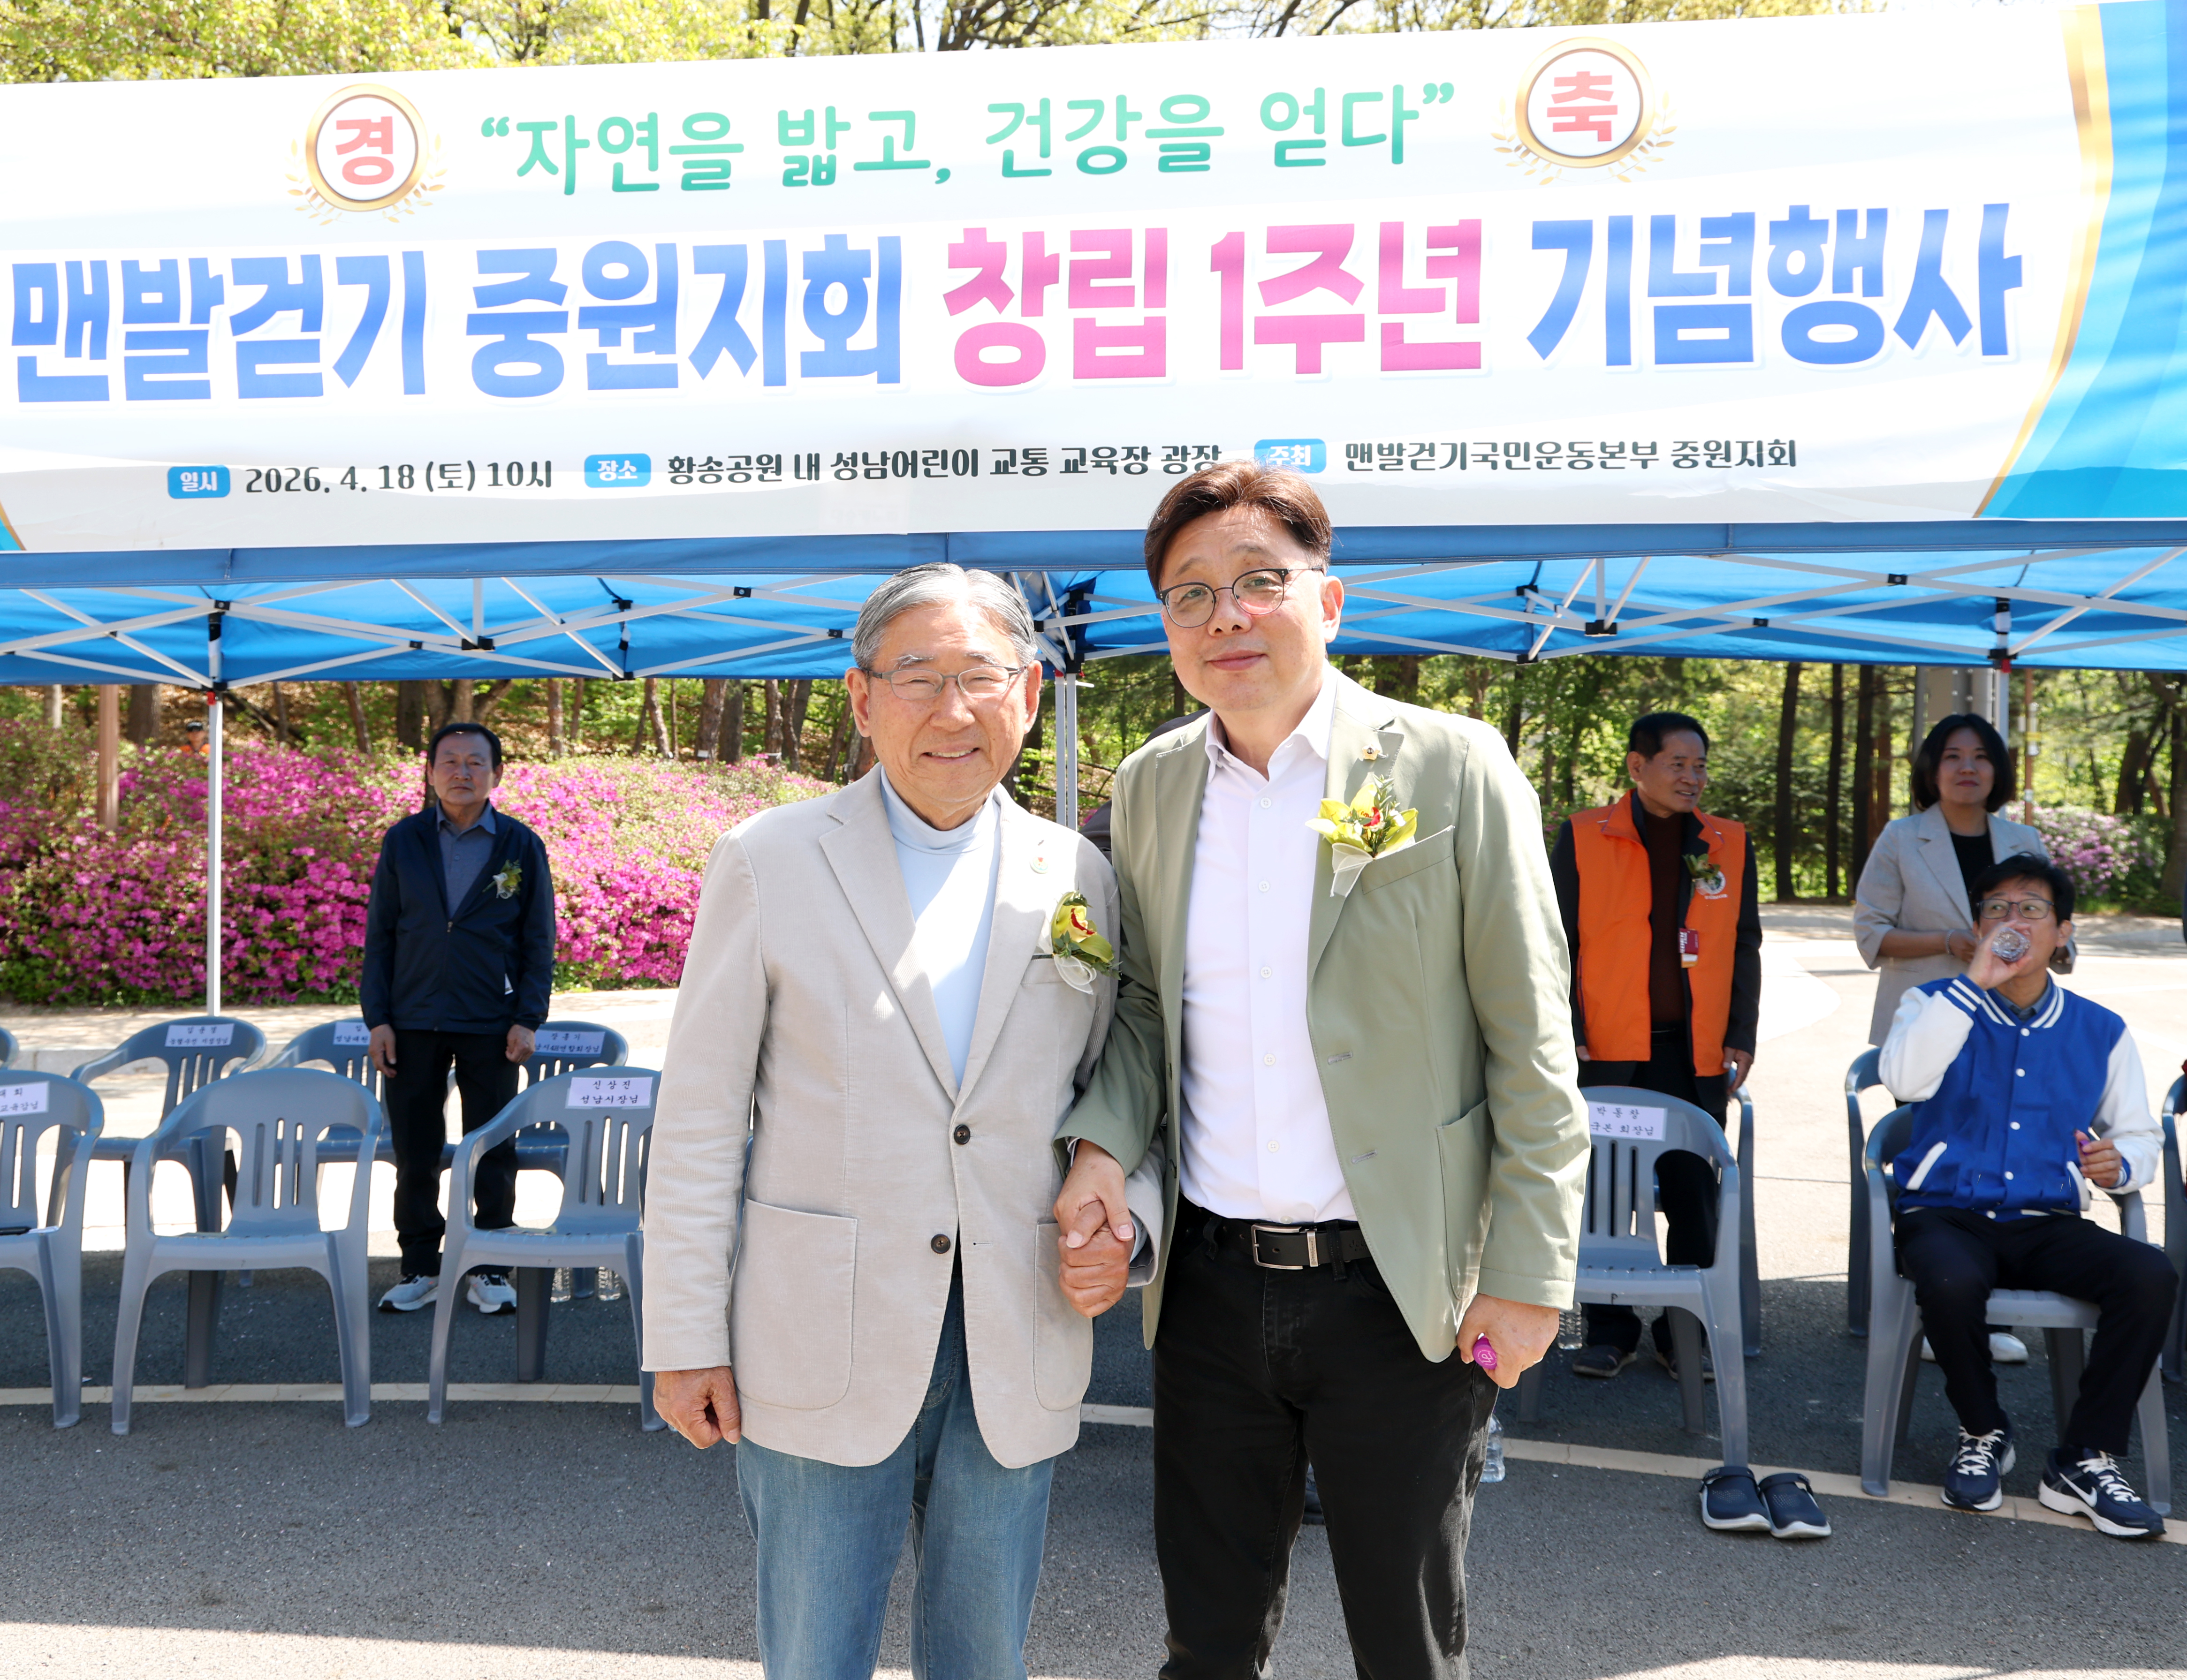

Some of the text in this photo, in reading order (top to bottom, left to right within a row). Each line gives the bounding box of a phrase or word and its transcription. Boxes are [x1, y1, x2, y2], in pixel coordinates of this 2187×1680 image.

[1547, 71, 1618, 142] 축
[335, 116, 394, 185] 경
[482, 83, 1453, 195] “자연을 밟고, 건강을 얻다”
[12, 204, 2021, 402] 맨발걷기 중원지회 창립 1주년 기념행사
[181, 472, 217, 492] 일시
[246, 467, 329, 493] 2026.
[341, 466, 366, 492] 4.
[488, 461, 551, 487] 10시
[598, 445, 1222, 484] 장소 황송공원 내 성남어린이 교통 교육장 광장
[1269, 439, 1796, 471] 주최 맨발걷기국민운동본부 중원지회
[580, 1094, 638, 1104] 성남시장님
